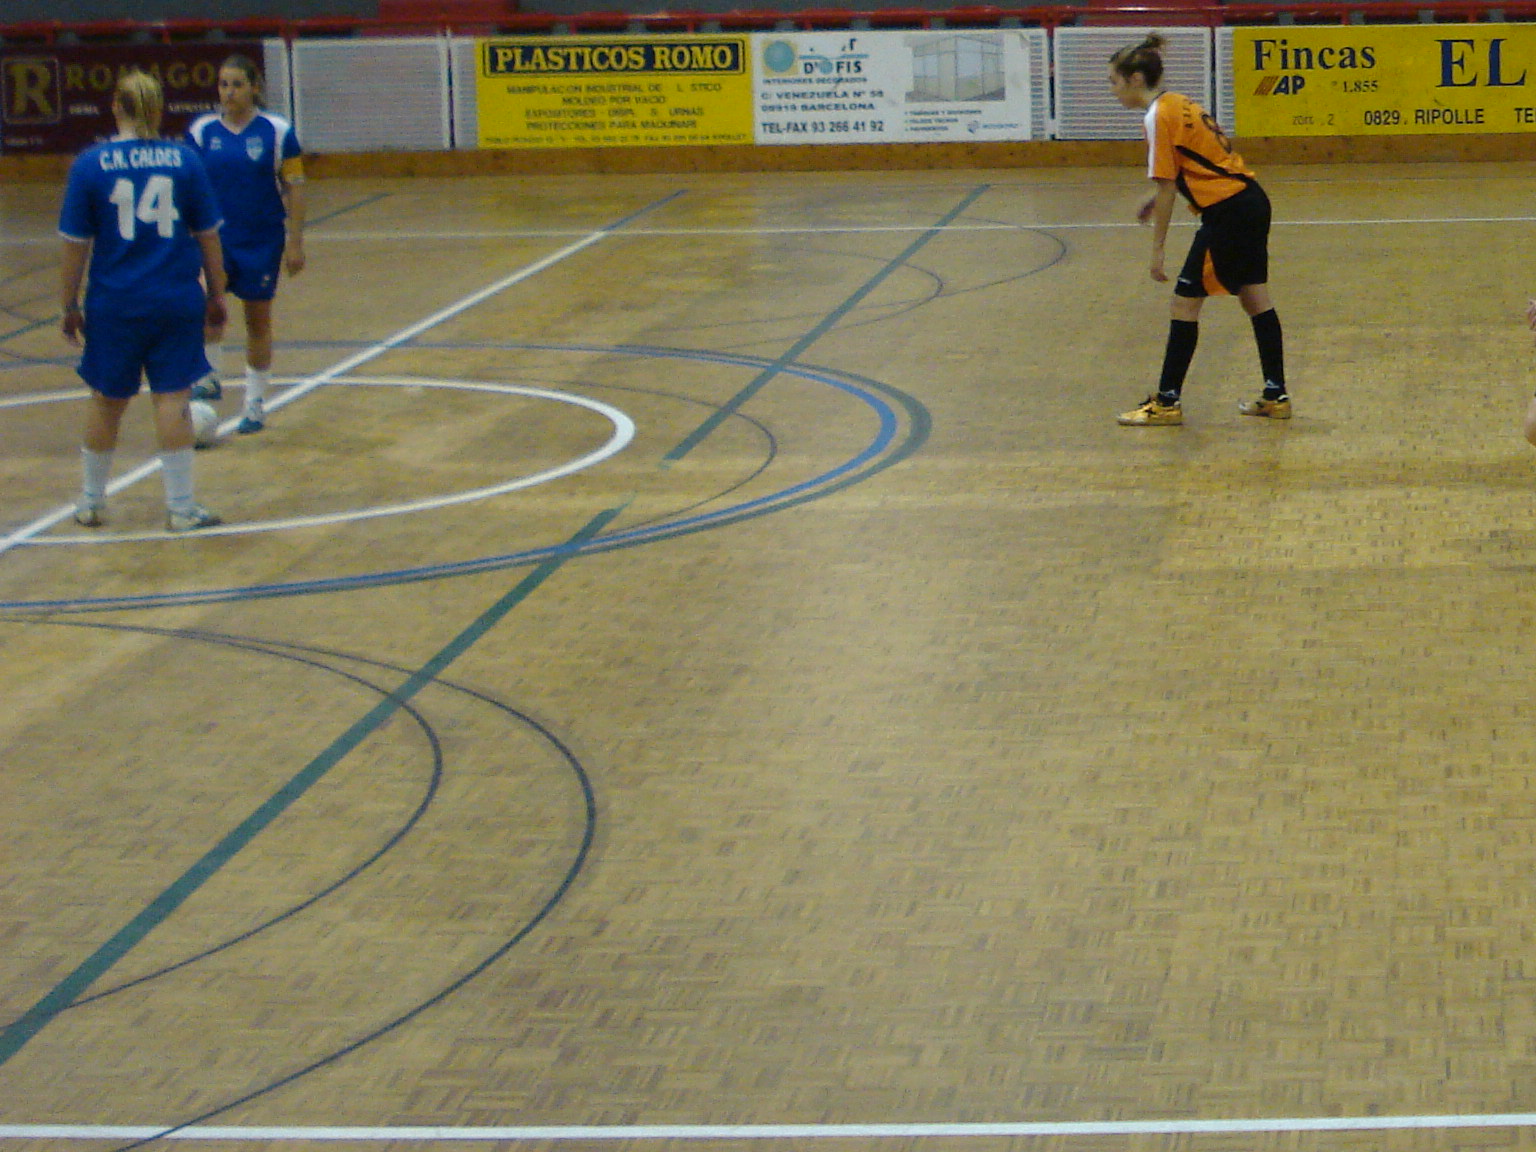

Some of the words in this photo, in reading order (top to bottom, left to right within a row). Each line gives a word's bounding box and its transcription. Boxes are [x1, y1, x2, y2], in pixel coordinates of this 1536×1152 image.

[495, 46, 646, 71] PLASTICOS
[652, 45, 734, 70] ROMO
[1251, 38, 1376, 70] Fincas
[1434, 38, 1527, 88] EL
[1273, 75, 1306, 95] AP
[800, 102, 875, 112] BARCELONA
[762, 121, 808, 135] TEL-FAX
[811, 122, 826, 134] 93
[829, 121, 849, 133] 266
[852, 120, 866, 133] 41
[870, 120, 885, 132] 92
[129, 147, 183, 170] CALDES
[108, 174, 181, 242] 14
